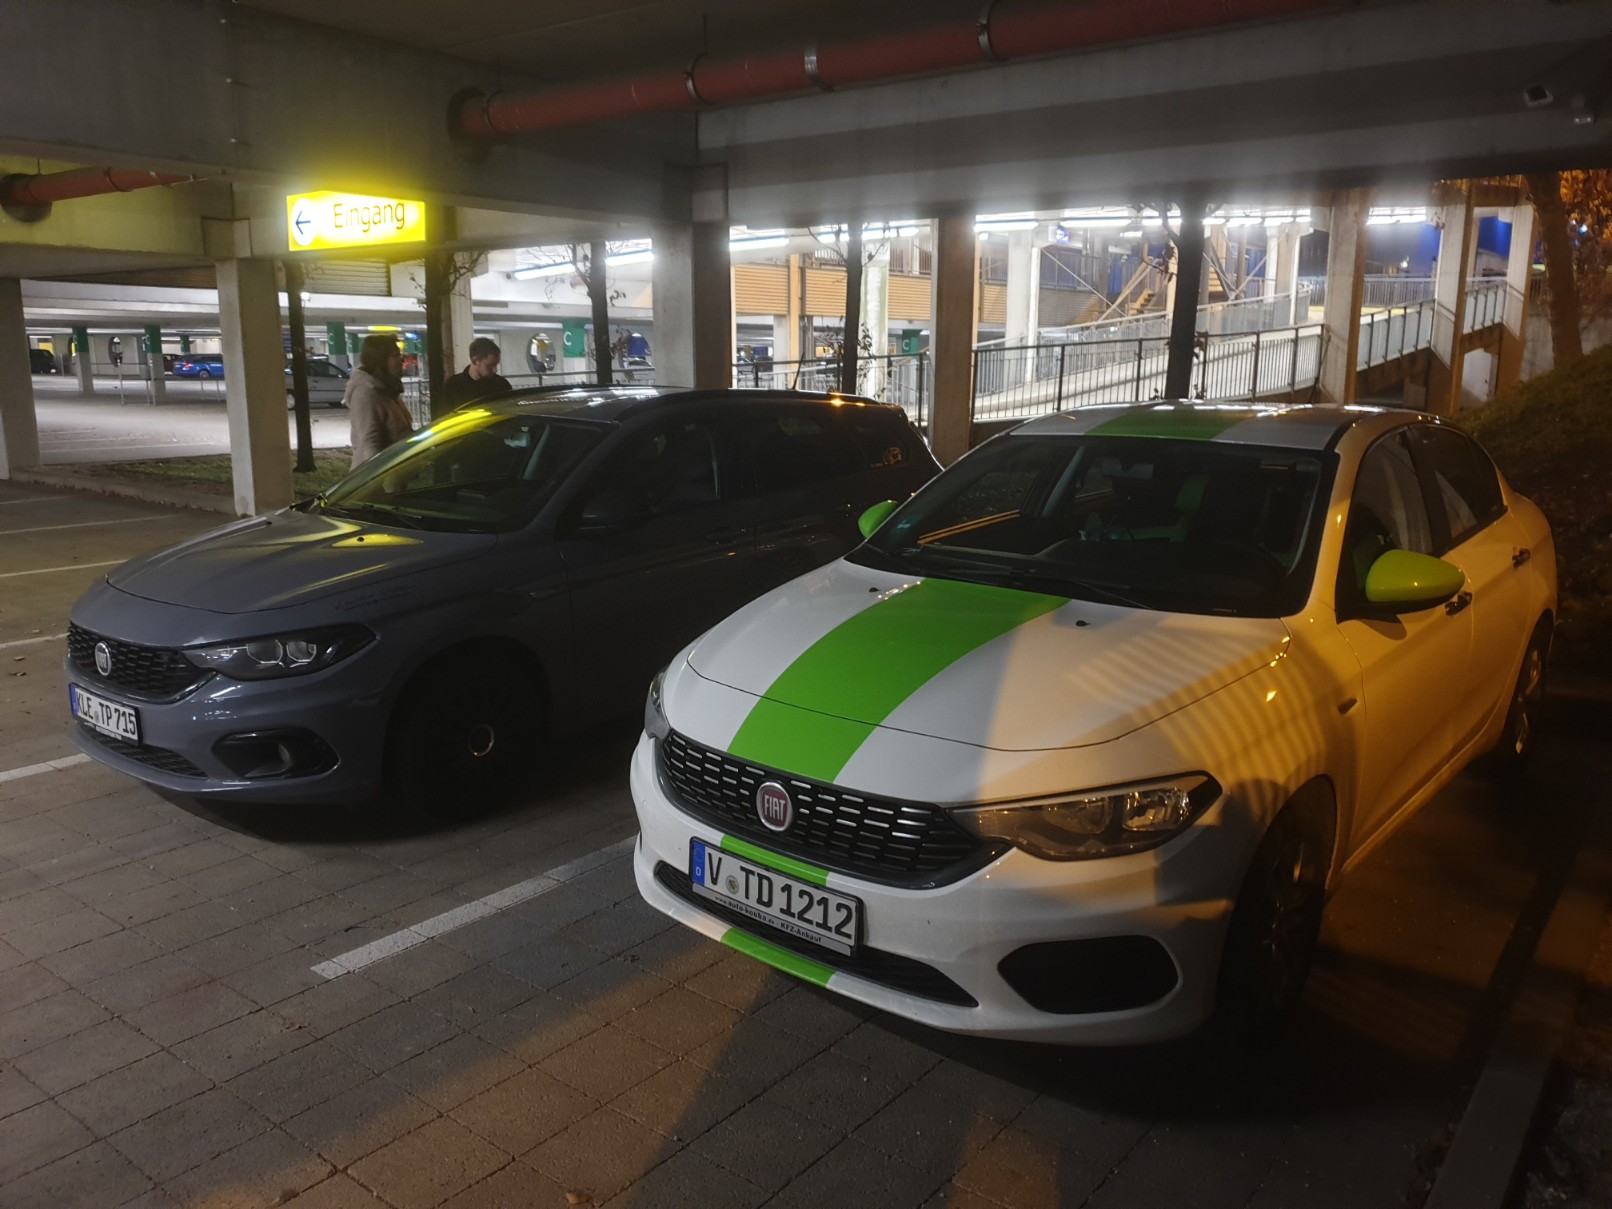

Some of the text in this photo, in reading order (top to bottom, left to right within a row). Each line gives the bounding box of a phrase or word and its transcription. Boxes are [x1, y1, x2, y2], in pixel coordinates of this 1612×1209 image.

[333, 203, 405, 233] Eingang
[563, 331, 572, 346] C
[902, 339, 910, 350] C
[98, 702, 112, 727] TP
[114, 708, 136, 735] 715
[764, 795, 785, 821] FIAT
[695, 866, 702, 877] D
[708, 853, 852, 940] V TD 1212
[780, 922, 822, 943] KFZ-Ankauf
